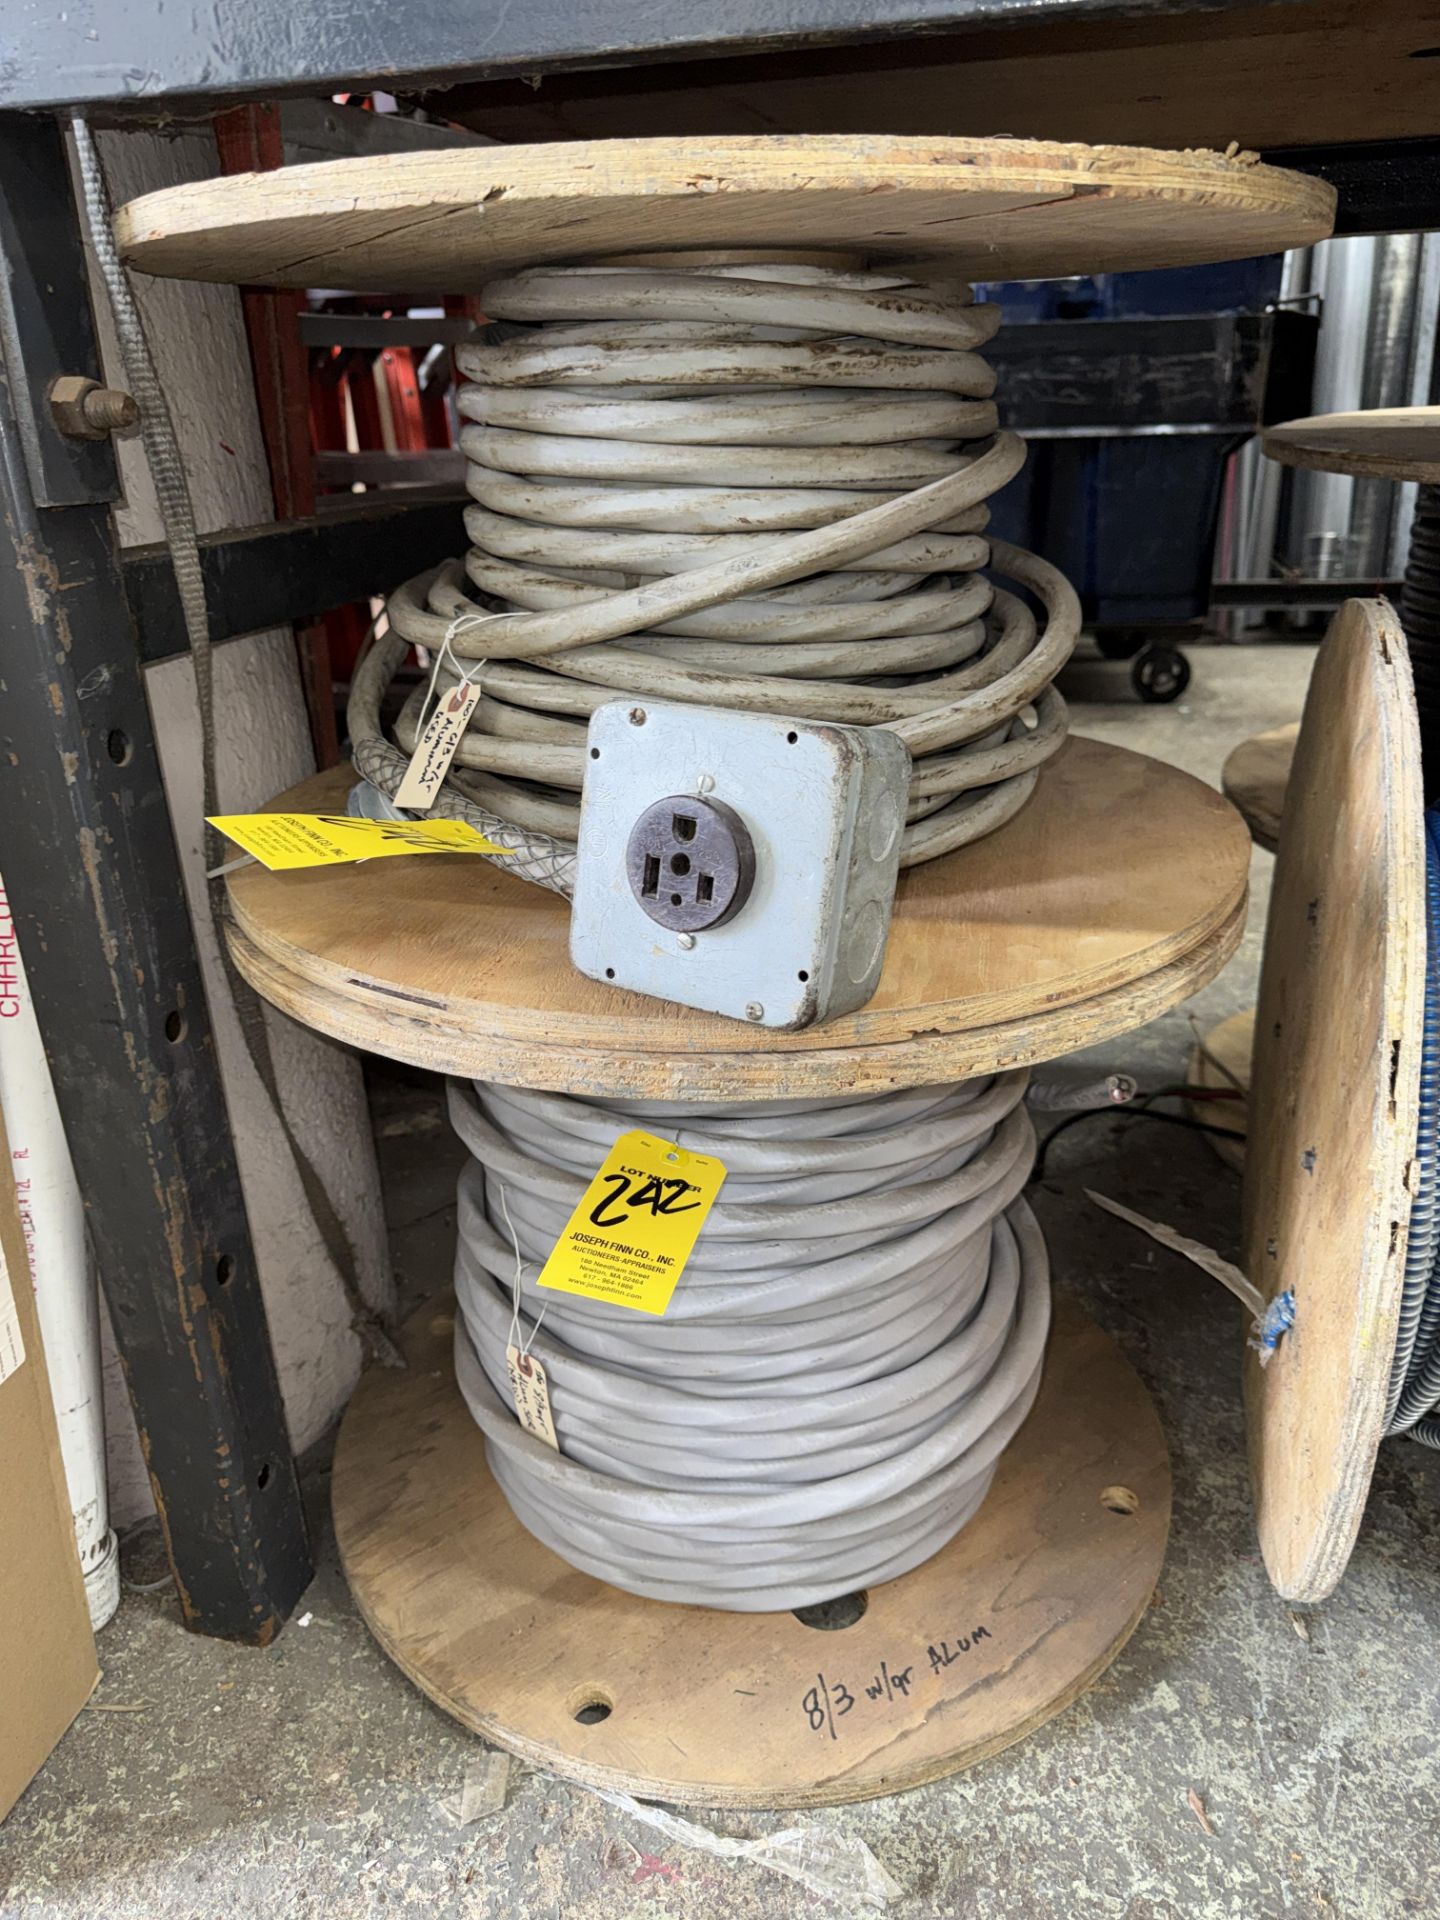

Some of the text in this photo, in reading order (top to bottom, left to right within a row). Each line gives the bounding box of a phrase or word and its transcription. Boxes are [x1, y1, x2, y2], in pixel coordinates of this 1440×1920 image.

[620, 1165, 702, 1193] LOT NUBER
[590, 1174, 701, 1227] 242
[569, 1231, 609, 1248] JOSEPH
[609, 1242, 634, 1256] FINN
[656, 1254, 676, 1268] INC.
[571, 1245, 666, 1274] AUCTIONEERS-APPRAISERS
[594, 1260, 628, 1274] Needham
[628, 1269, 650, 1280] Street
[610, 1271, 622, 1280] MA
[802, 1673, 855, 1740] 8/3
